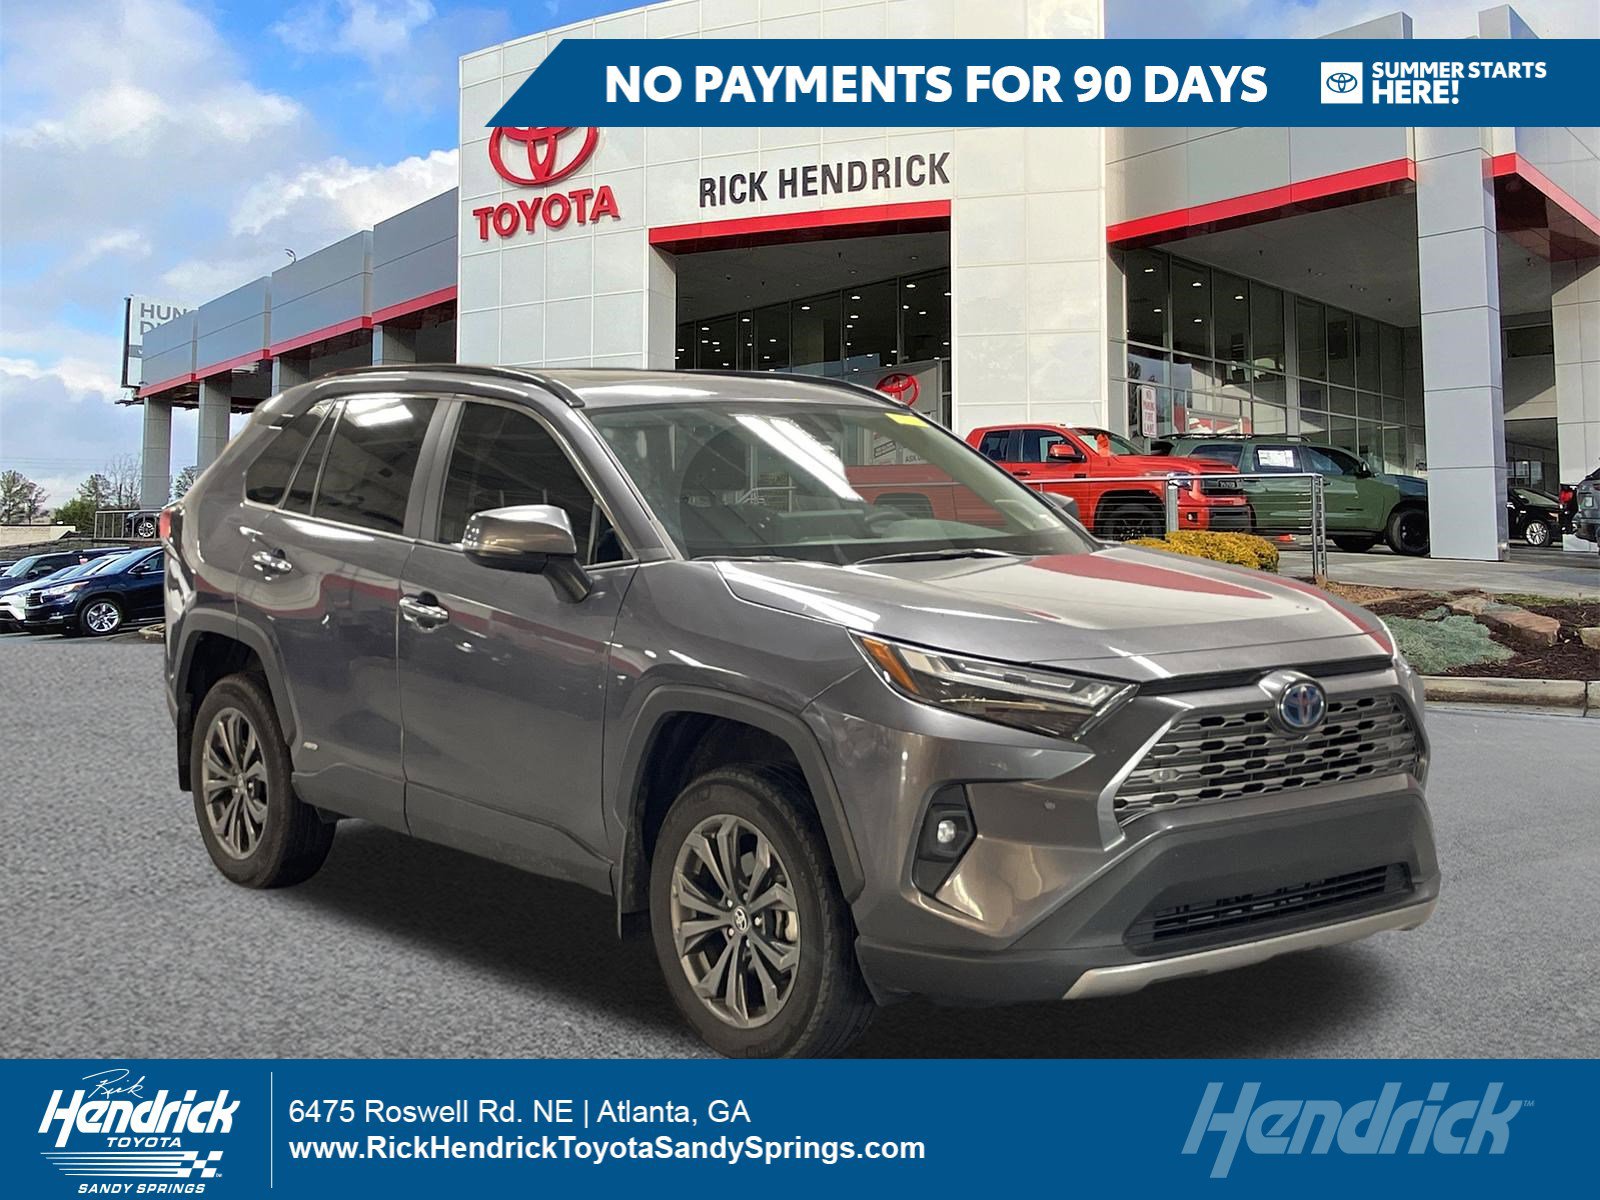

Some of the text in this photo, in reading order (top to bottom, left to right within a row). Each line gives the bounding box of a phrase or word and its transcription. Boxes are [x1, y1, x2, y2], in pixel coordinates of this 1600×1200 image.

[700, 152, 950, 207] RICK HENDRICK
[473, 185, 620, 241] TOYOTA
